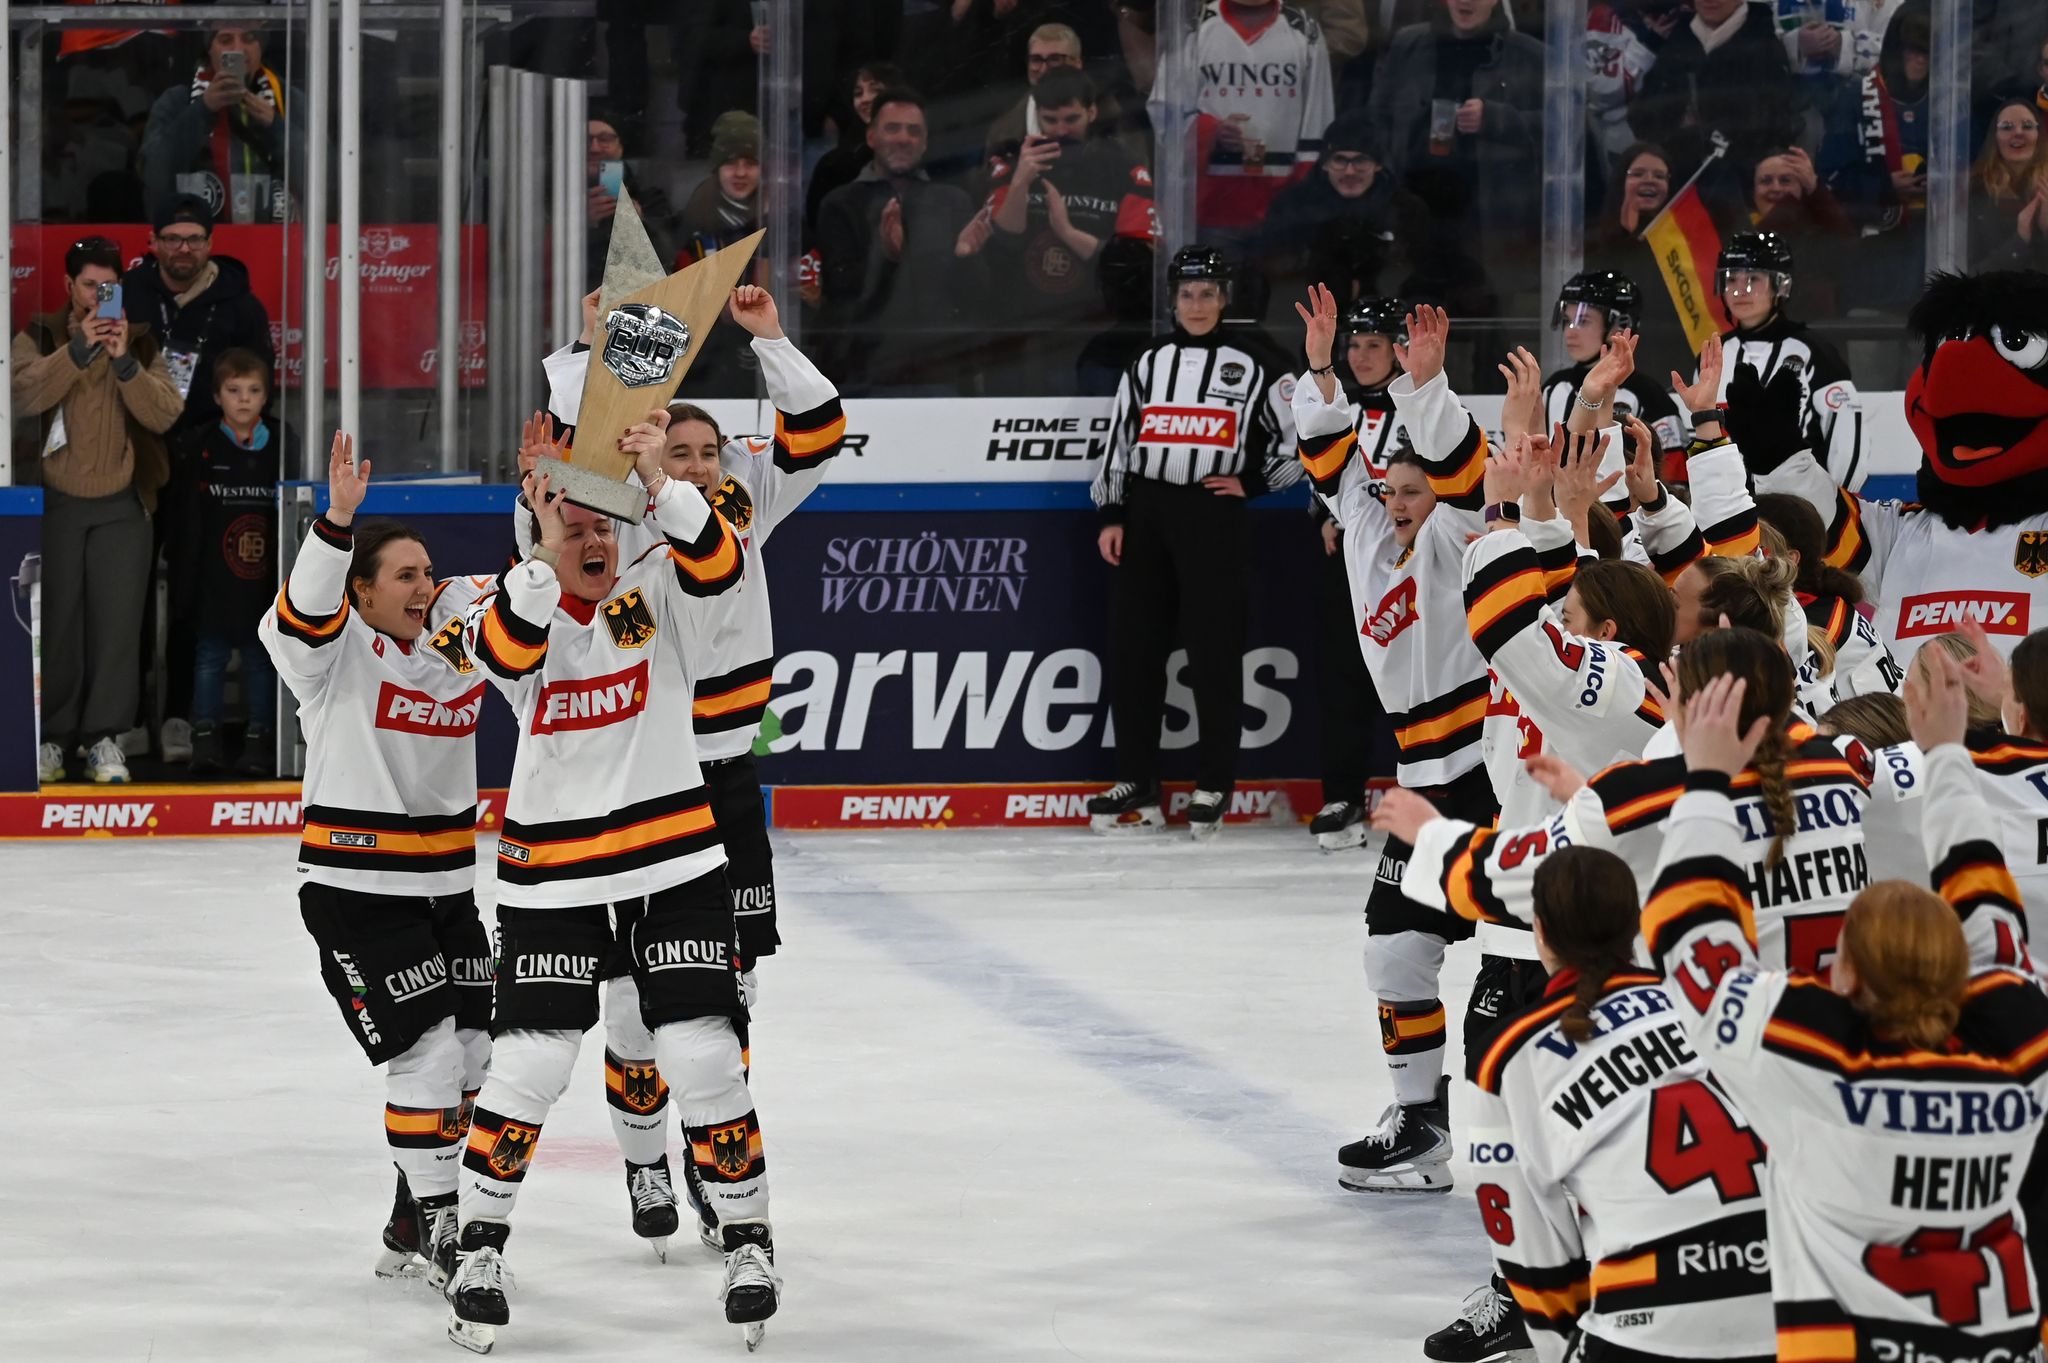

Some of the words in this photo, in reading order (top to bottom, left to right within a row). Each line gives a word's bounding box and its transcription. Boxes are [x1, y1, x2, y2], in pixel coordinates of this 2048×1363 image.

[1201, 62, 1297, 87] WINGS
[610, 327, 676, 363] CUP
[992, 418, 1080, 433] HOME
[986, 438, 1107, 461] HOCK
[821, 531, 1028, 574] SCHÖNER
[821, 576, 1028, 613] WOHNEN
[1004, 794, 1091, 819] PENN
[731, 883, 773, 910] NQUE
[644, 939, 728, 966] CINQUE
[385, 952, 447, 997] CINQU
[515, 953, 599, 979] CINQUE
[1552, 1020, 1698, 1130] WEICHE
[1470, 1143, 1514, 1164] ICO
[751, 1225, 764, 1236] 20
